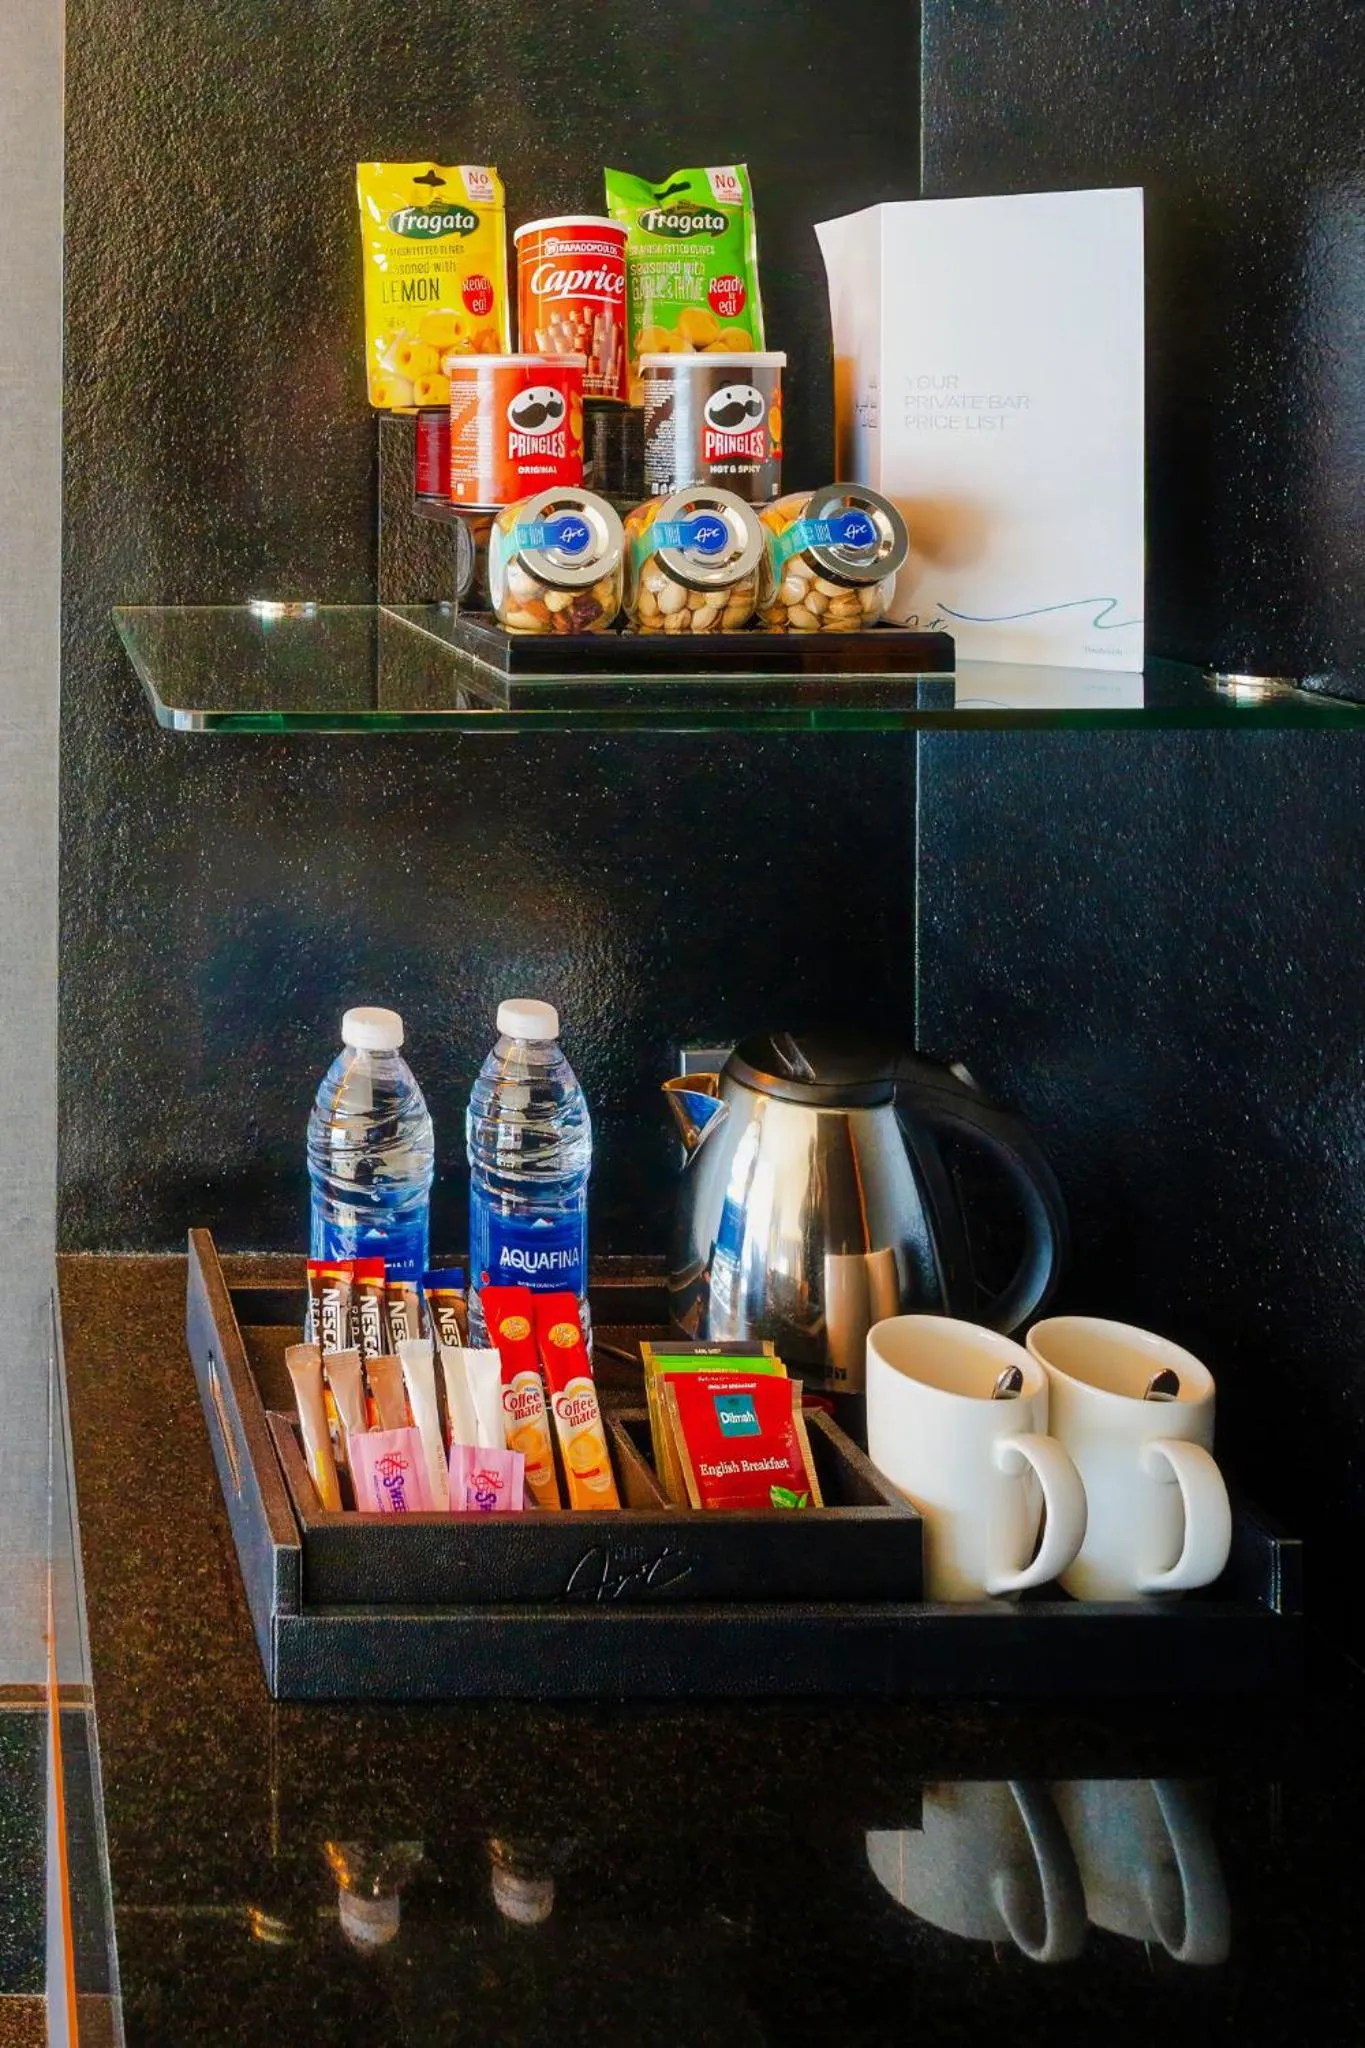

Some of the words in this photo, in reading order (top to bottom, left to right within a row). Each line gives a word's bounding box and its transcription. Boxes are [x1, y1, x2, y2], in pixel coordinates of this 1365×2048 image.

[468, 171, 488, 185] No
[715, 174, 735, 188] No
[396, 208, 475, 234] Fragata
[646, 208, 725, 234] Fragata
[530, 262, 625, 296] Caprice
[709, 276, 745, 294] Ready
[382, 277, 440, 303] LEMON
[904, 375, 959, 389] YOUR
[904, 395, 984, 409] PRIVATE
[989, 395, 1031, 409] BAR
[904, 415, 960, 430] PRICE
[966, 415, 1006, 430] LIST
[508, 431, 565, 459] PRINGLES
[705, 431, 764, 458] PRINGLES
[517, 465, 557, 475] ORIGINAL
[710, 465, 728, 474] HOT
[738, 464, 761, 473] SPICY
[499, 1246, 580, 1273] AQUAFINA
[322, 1288, 341, 1354] NESCA
[360, 1296, 381, 1359] NESCA
[502, 1389, 541, 1412] Coffee
[556, 1397, 594, 1419] Coffee
[514, 1403, 542, 1420] mate
[570, 1409, 598, 1427] mate
[720, 1411, 755, 1424] Dilmah
[699, 1462, 740, 1477] English
[742, 1457, 789, 1473] Breakfast
